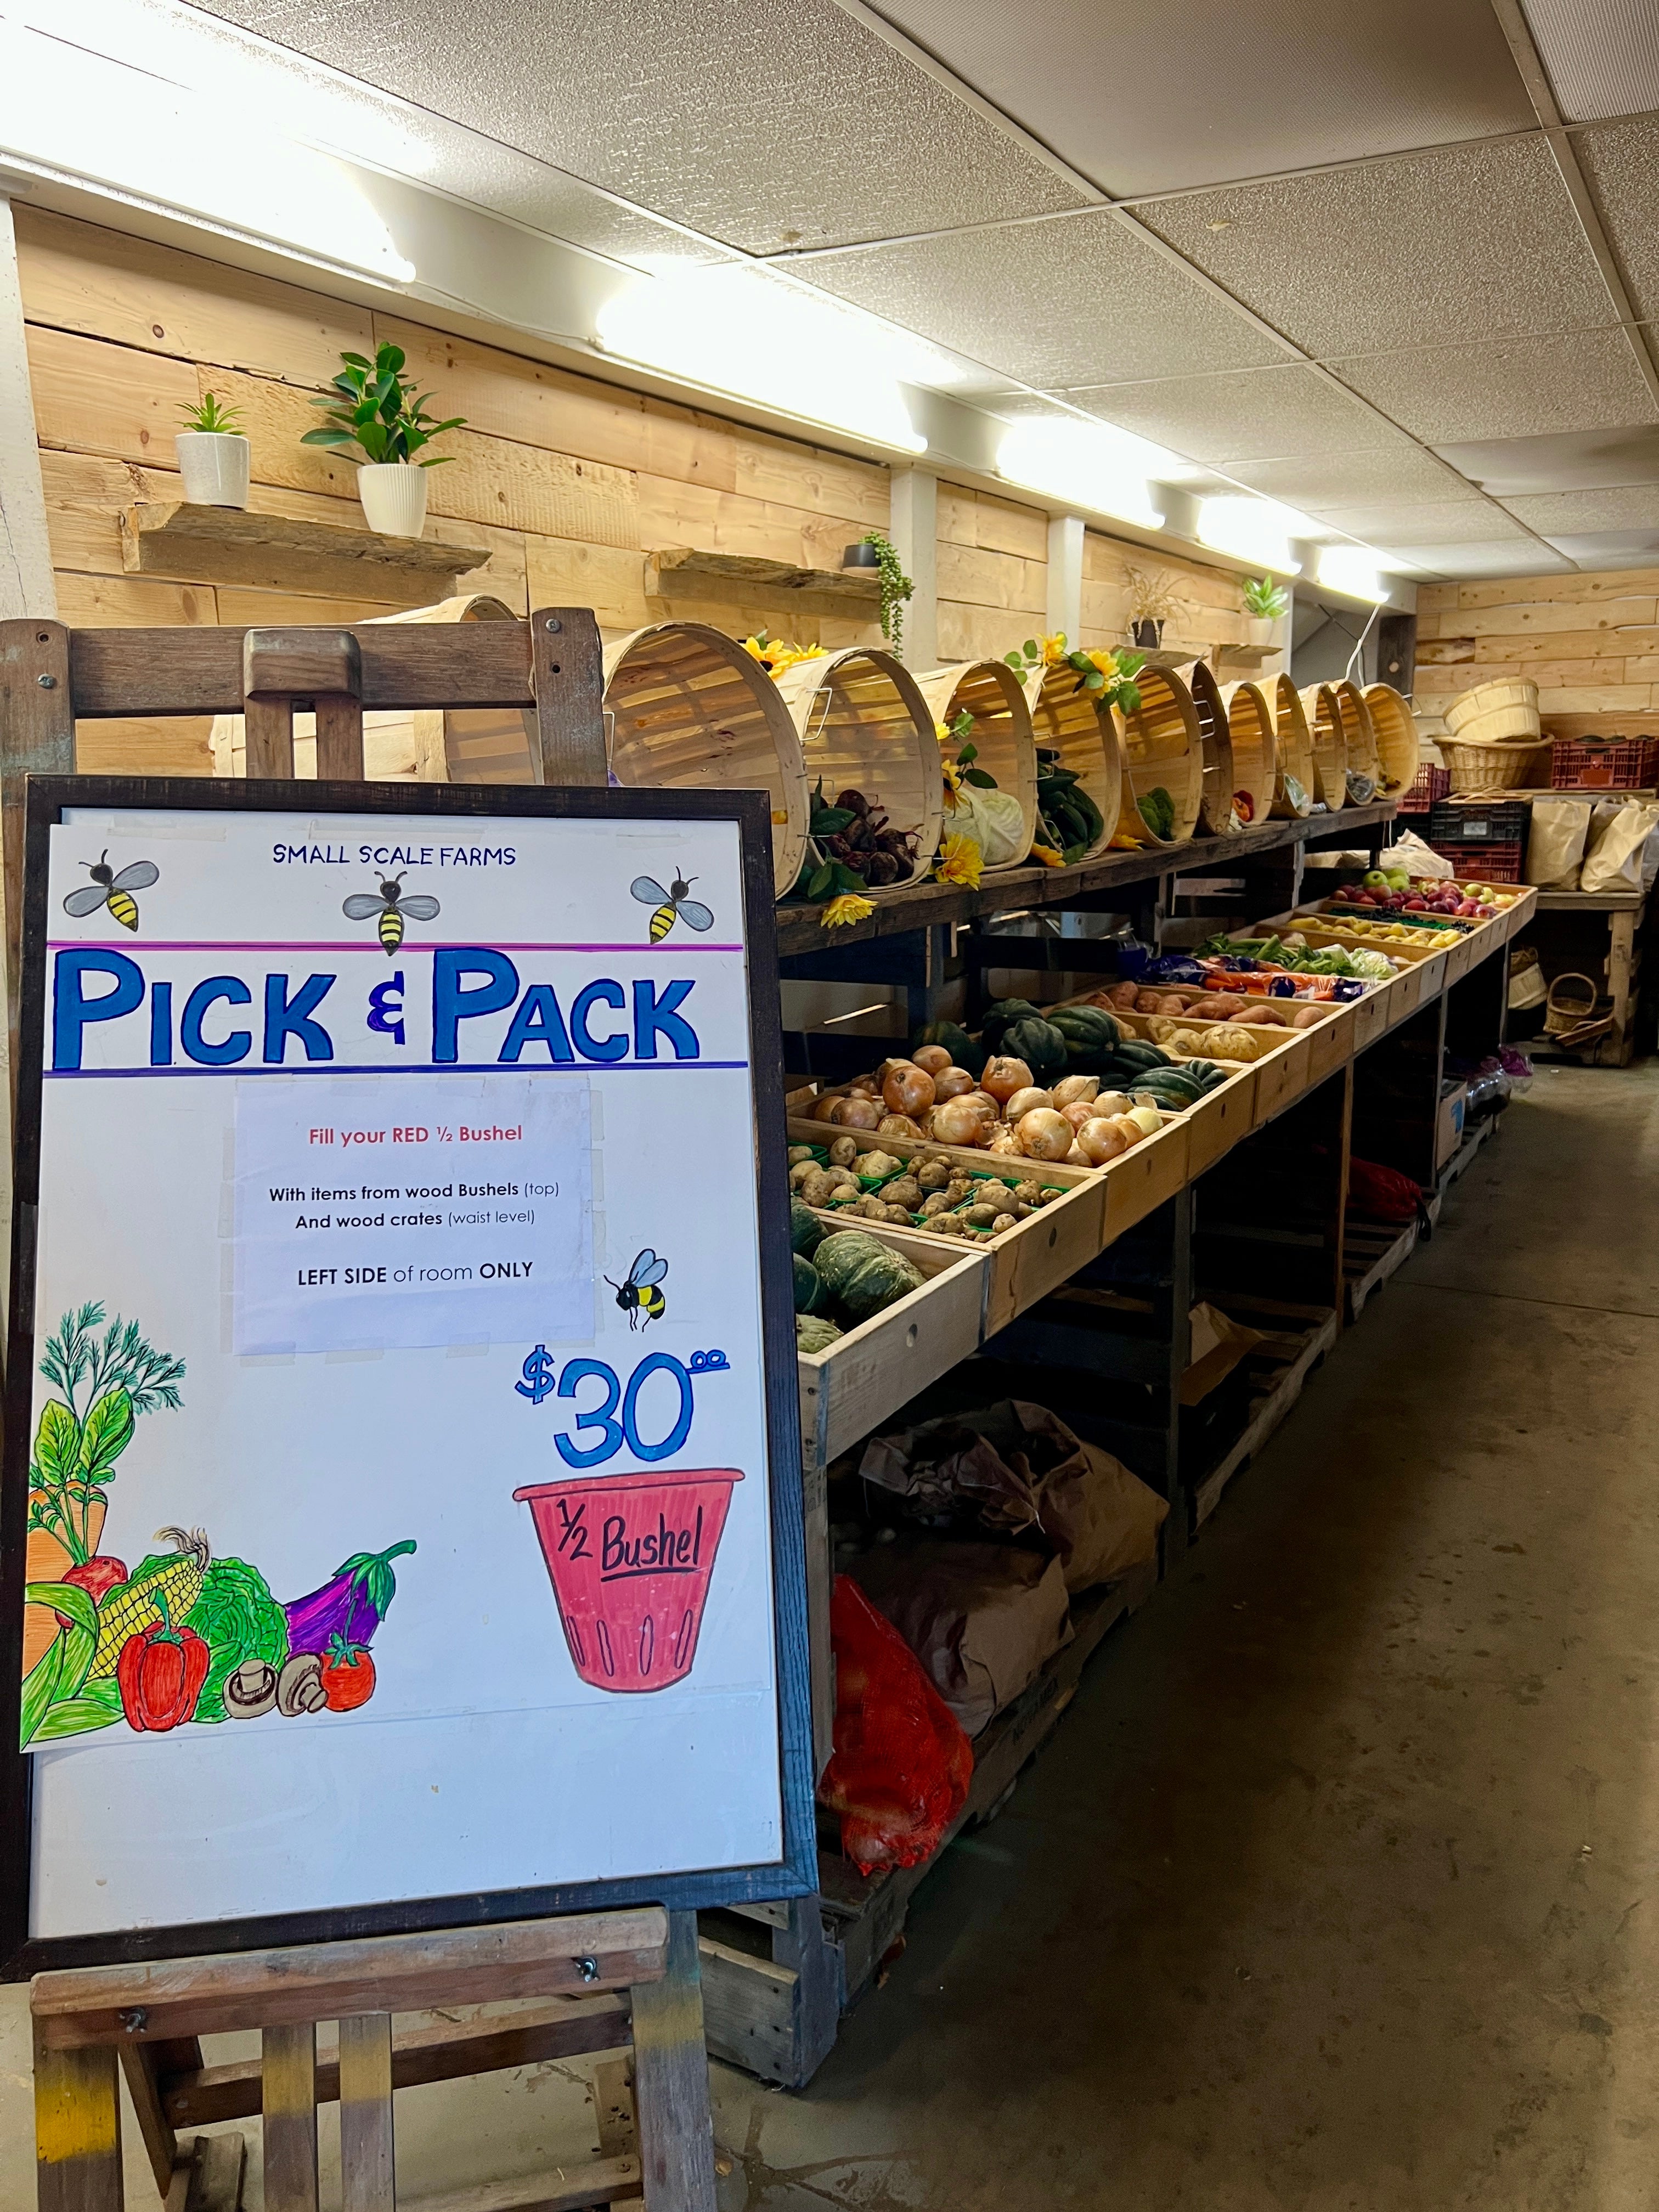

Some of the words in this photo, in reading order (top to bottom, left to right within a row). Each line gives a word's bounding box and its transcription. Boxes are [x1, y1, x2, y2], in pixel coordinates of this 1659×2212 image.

[274, 844, 350, 864] SMALL
[359, 845, 433, 865] SCALE
[441, 848, 516, 866] FARMS
[53, 949, 336, 1070] PICK
[368, 971, 405, 1045] &
[432, 947, 701, 1064] PACK
[309, 1128, 334, 1144] Fill
[341, 1130, 386, 1147] your
[393, 1127, 428, 1143] RED
[460, 1125, 522, 1142] Bushel
[269, 1187, 305, 1201] With
[312, 1187, 356, 1201] items
[362, 1186, 400, 1200] from
[405, 1184, 453, 1199] wood
[459, 1182, 518, 1197] Bushels
[524, 1182, 559, 1198] (top)
[295, 1215, 330, 1229] And
[336, 1213, 384, 1227] wood
[390, 1212, 442, 1226] crates
[449, 1211, 490, 1227] (waist
[495, 1210, 535, 1225] level)
[298, 1269, 337, 1285] LEFT
[345, 1267, 387, 1284] SIDE
[393, 1265, 414, 1282] of
[420, 1265, 472, 1282] room
[479, 1262, 533, 1279] ONLY
[603, 1505, 703, 1571] Bushel
